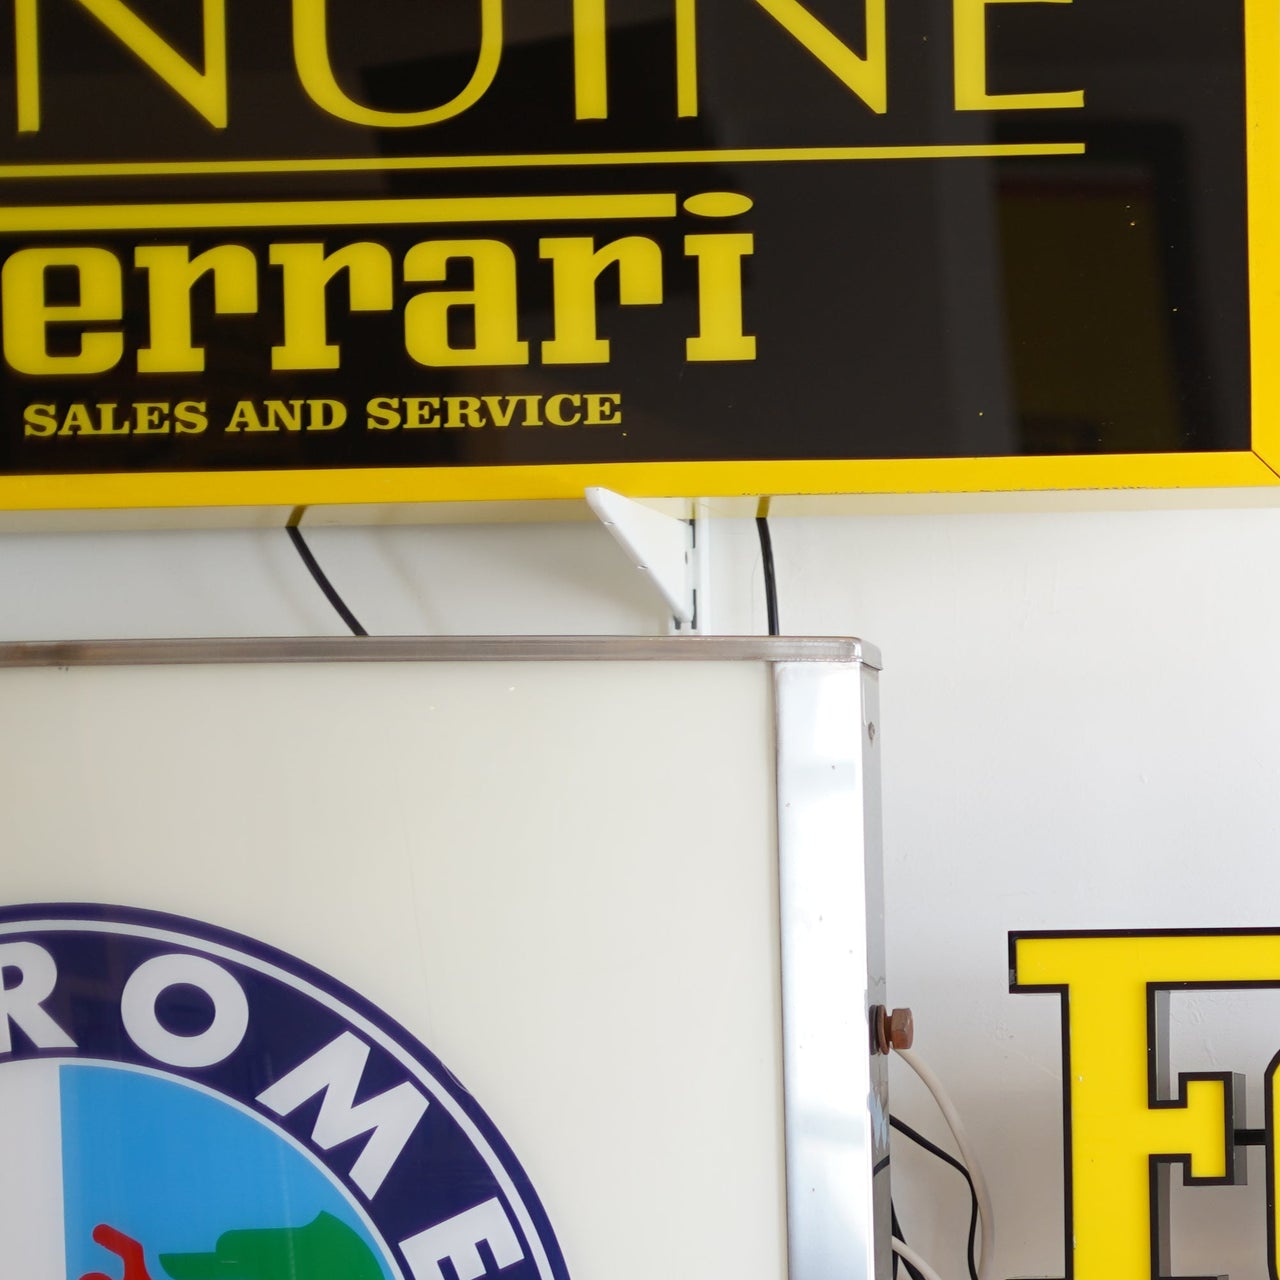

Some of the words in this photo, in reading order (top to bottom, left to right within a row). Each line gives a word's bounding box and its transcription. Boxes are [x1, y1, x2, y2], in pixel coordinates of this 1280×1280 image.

[0, 191, 757, 375] errari
[23, 398, 210, 437] SALES
[224, 398, 349, 434] AND
[364, 392, 624, 432] SERVICE
